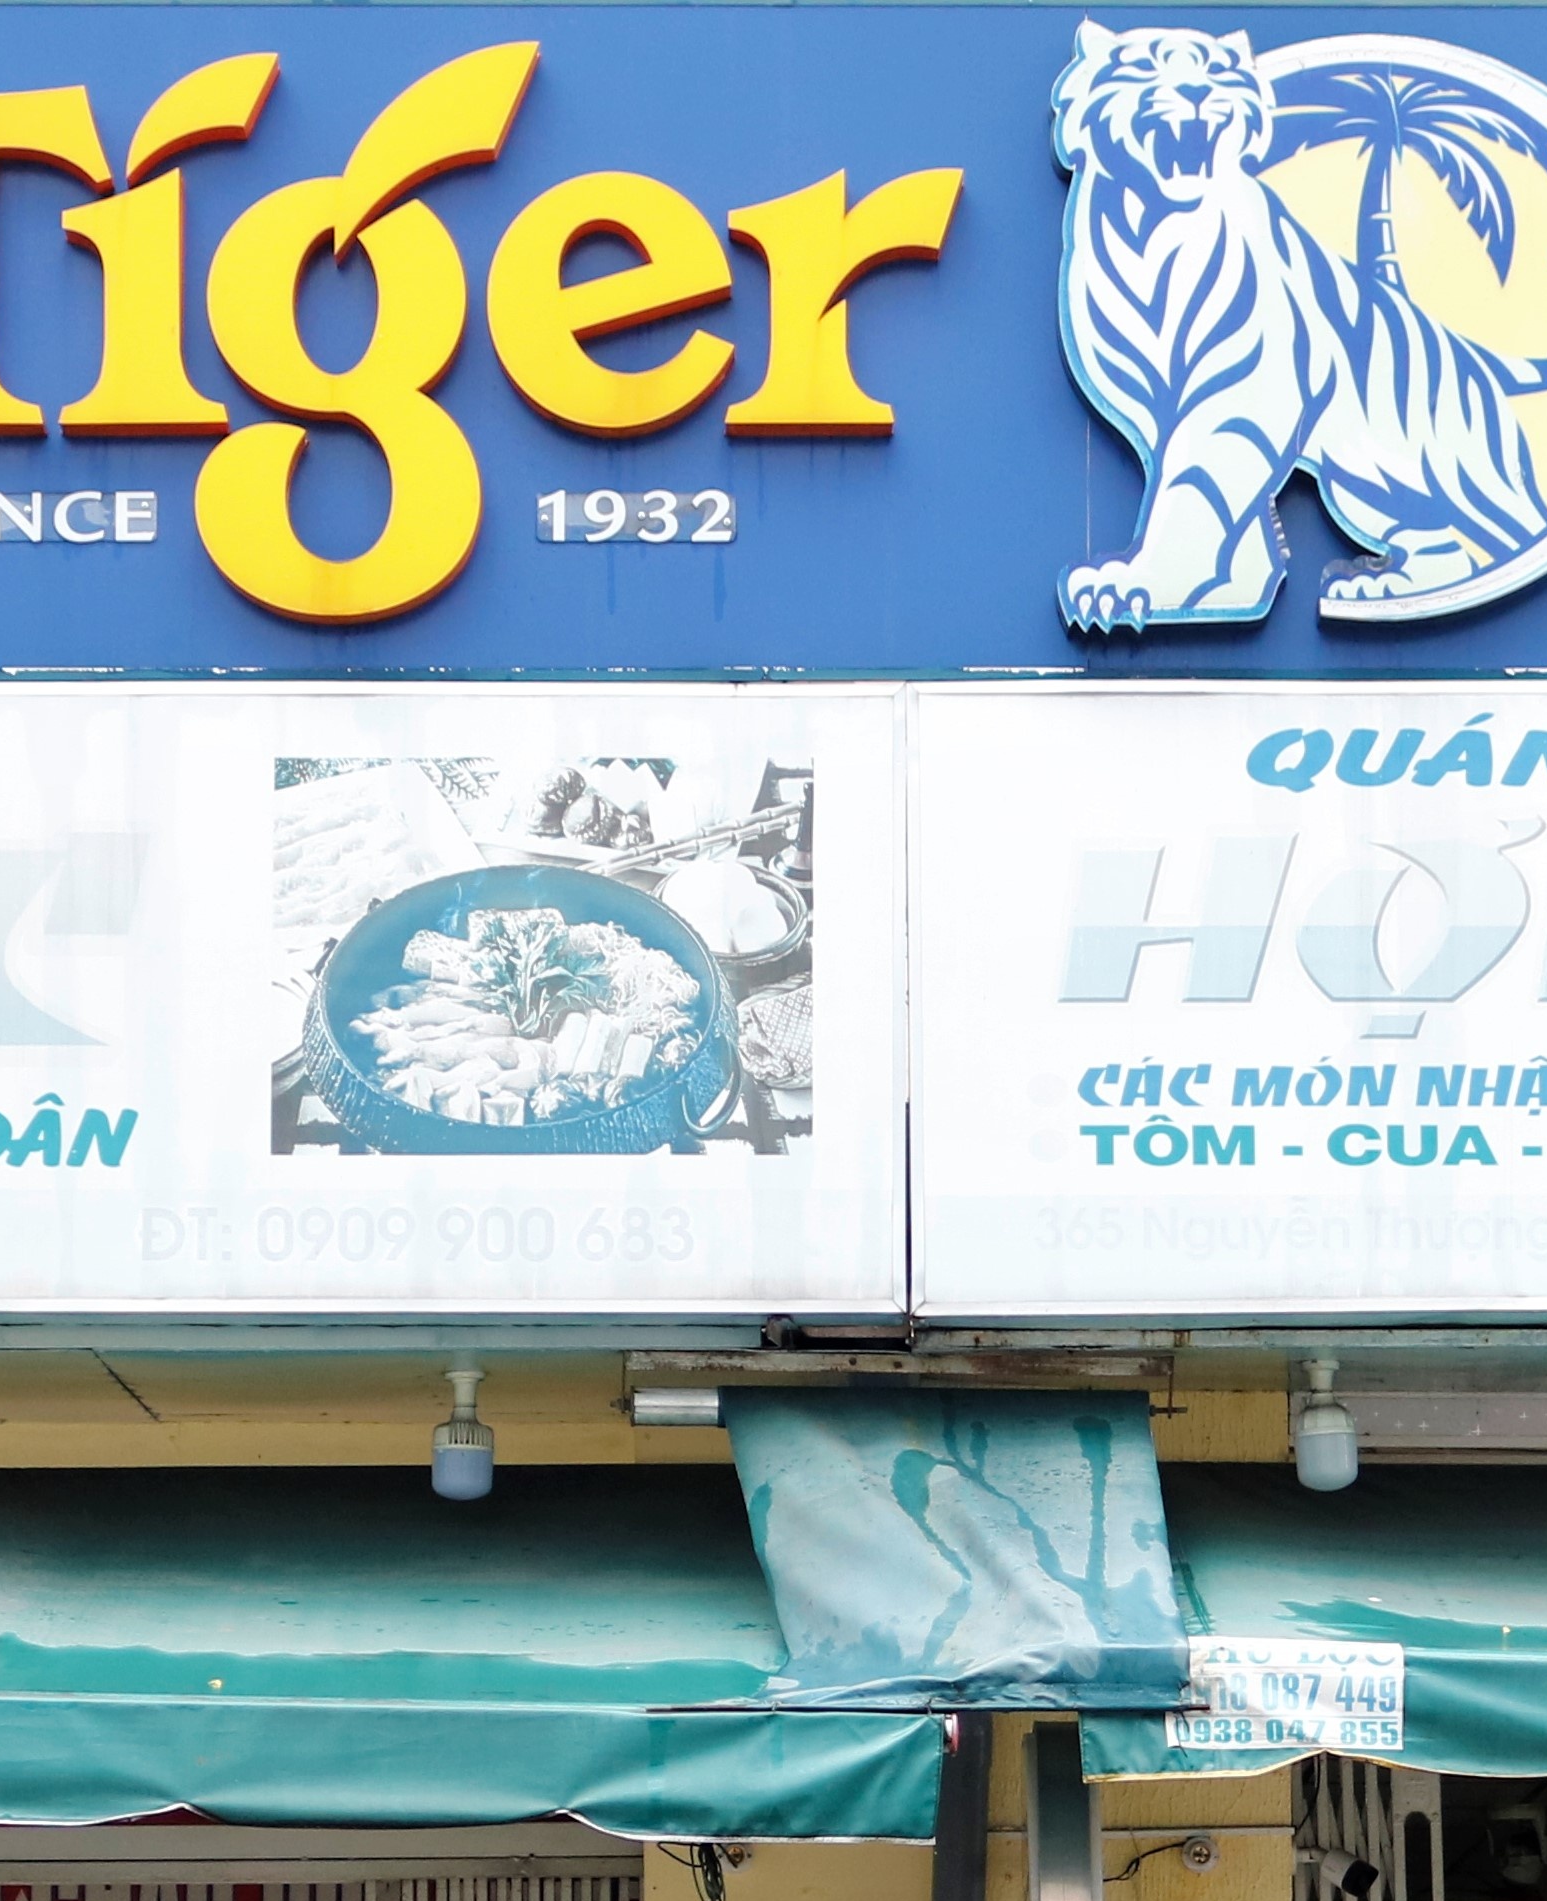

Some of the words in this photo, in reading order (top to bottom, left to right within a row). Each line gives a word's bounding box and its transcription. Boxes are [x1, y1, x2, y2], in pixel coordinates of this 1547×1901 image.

[537, 490, 735, 545] 1932
[1077, 1056, 1210, 1107] CÁC
[1232, 1054, 1396, 1107] MÓN
[1079, 1114, 1257, 1166] TÔM
[1327, 1123, 1498, 1168] CUA
[254, 1206, 411, 1262] 0909
[432, 1206, 555, 1262] 900
[575, 1206, 695, 1262] 683
[1035, 1207, 1125, 1252] 365
[1261, 1672, 1322, 1711] 087
[1335, 1673, 1397, 1713] 449
[1176, 1718, 1252, 1744] 0938
[1265, 1718, 1326, 1745] 047
[1339, 1720, 1399, 1746] 855
